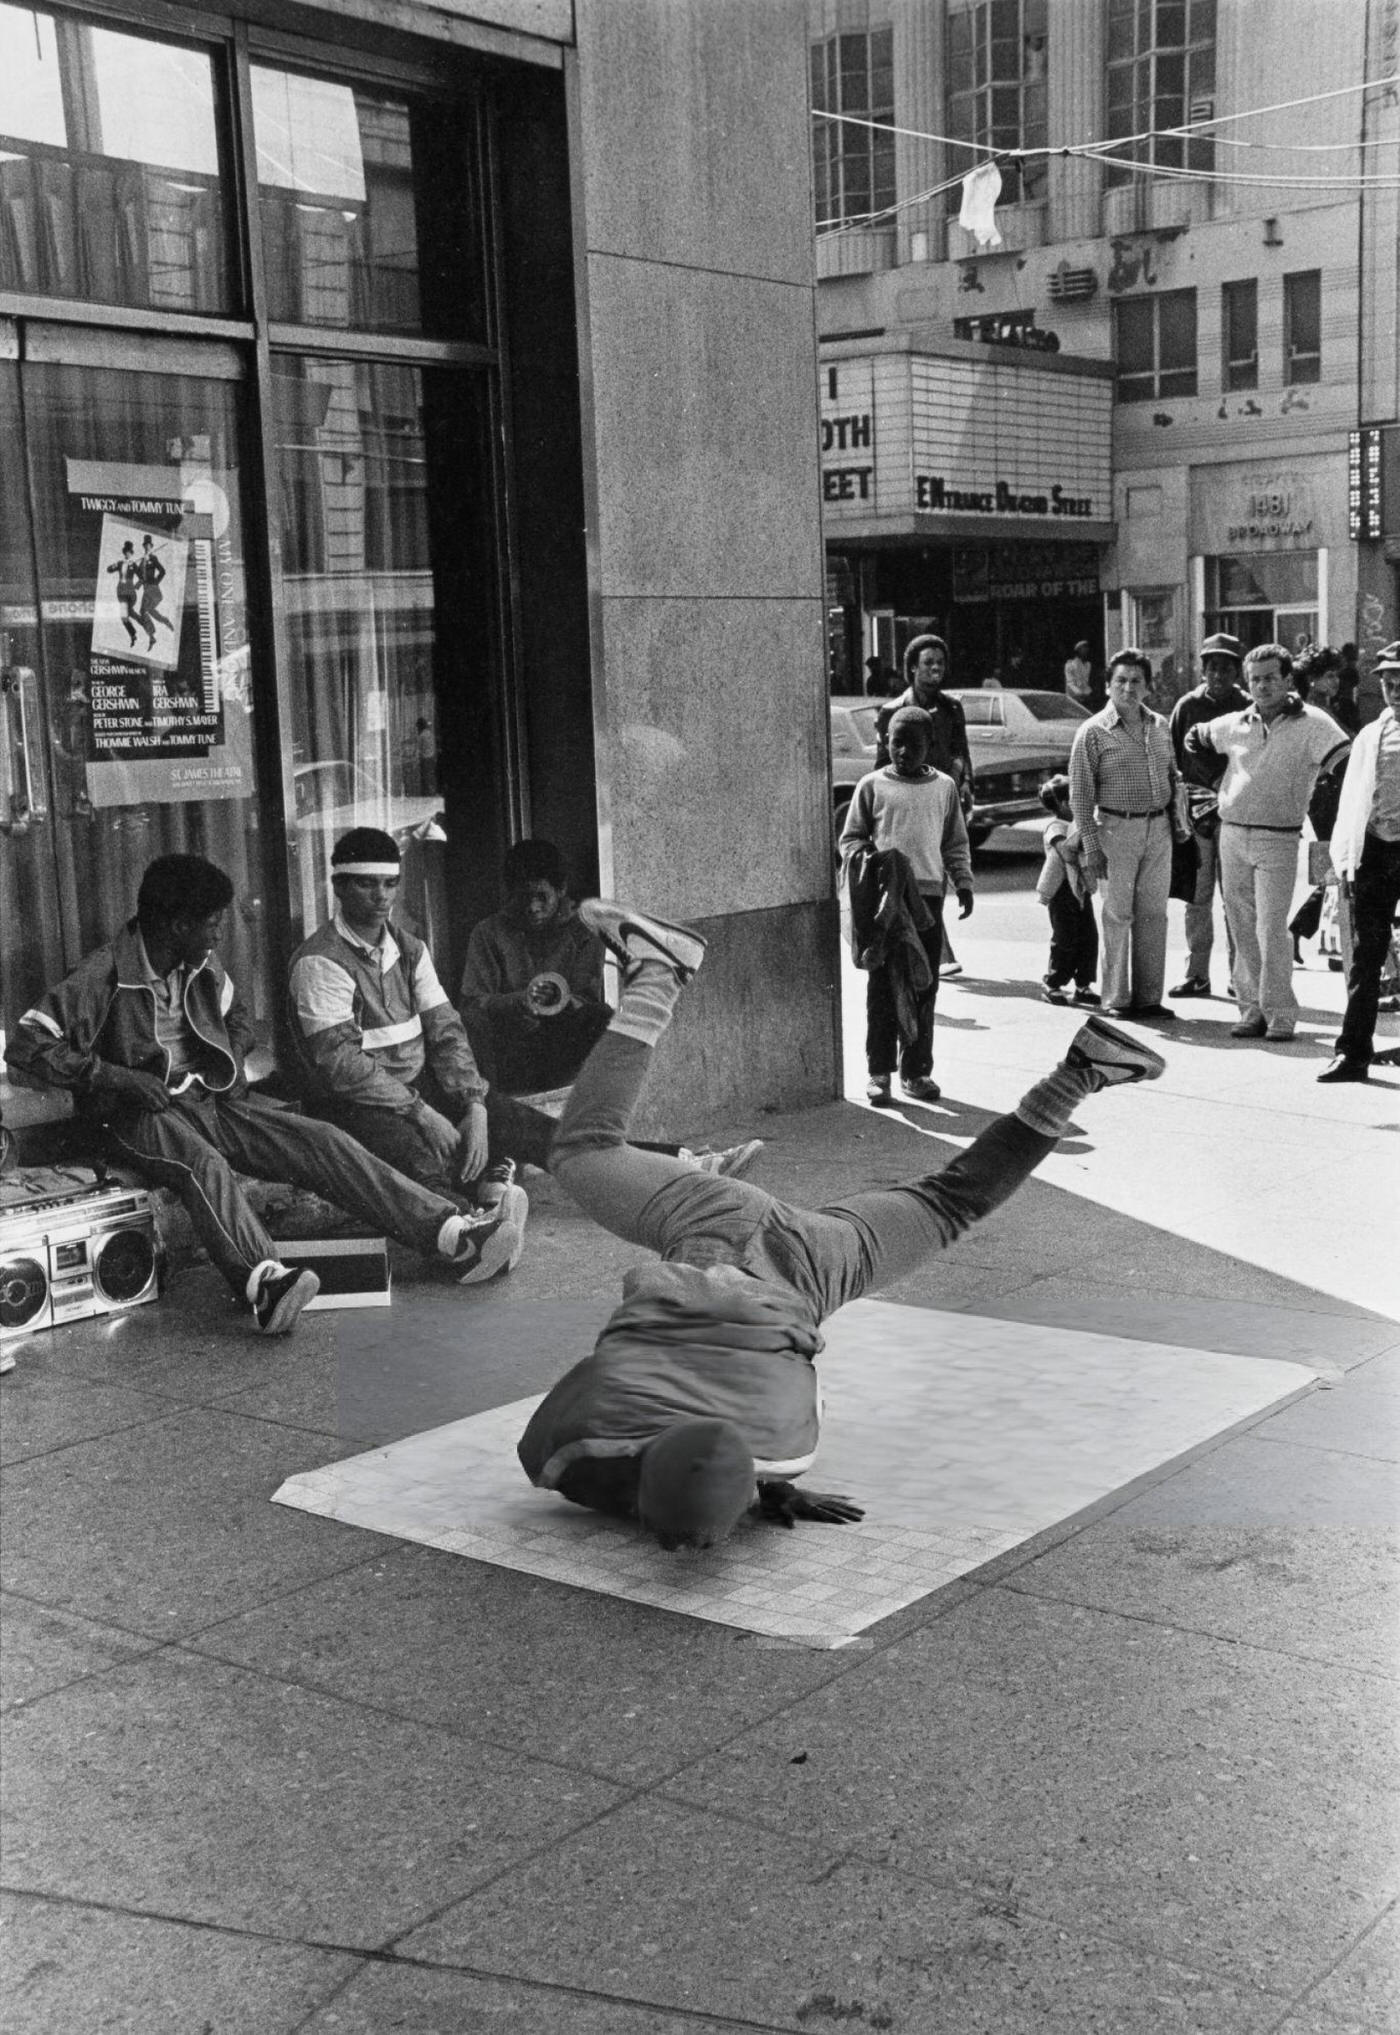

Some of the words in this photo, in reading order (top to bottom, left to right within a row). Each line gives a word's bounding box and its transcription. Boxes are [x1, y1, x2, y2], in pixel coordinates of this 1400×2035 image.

[81, 496, 117, 512] TWIGGY
[130, 500, 163, 514] TOMMY
[1227, 520, 1313, 541] BROADWAY
[1040, 581, 1064, 597] OF
[1066, 579, 1097, 596] THE
[91, 685, 126, 698] GEORGE
[91, 698, 139, 711] GERSHWIN
[152, 696, 198, 709] GERSHWIN
[93, 717, 118, 729] PETER
[119, 716, 144, 728] STONE
[152, 716, 185, 727] TIMOTHY
[95, 737, 132, 749] THOMMIE
[133, 735, 161, 747] WALSH
[169, 734, 196, 746] TOMMY
[197, 733, 217, 745] TUNE
